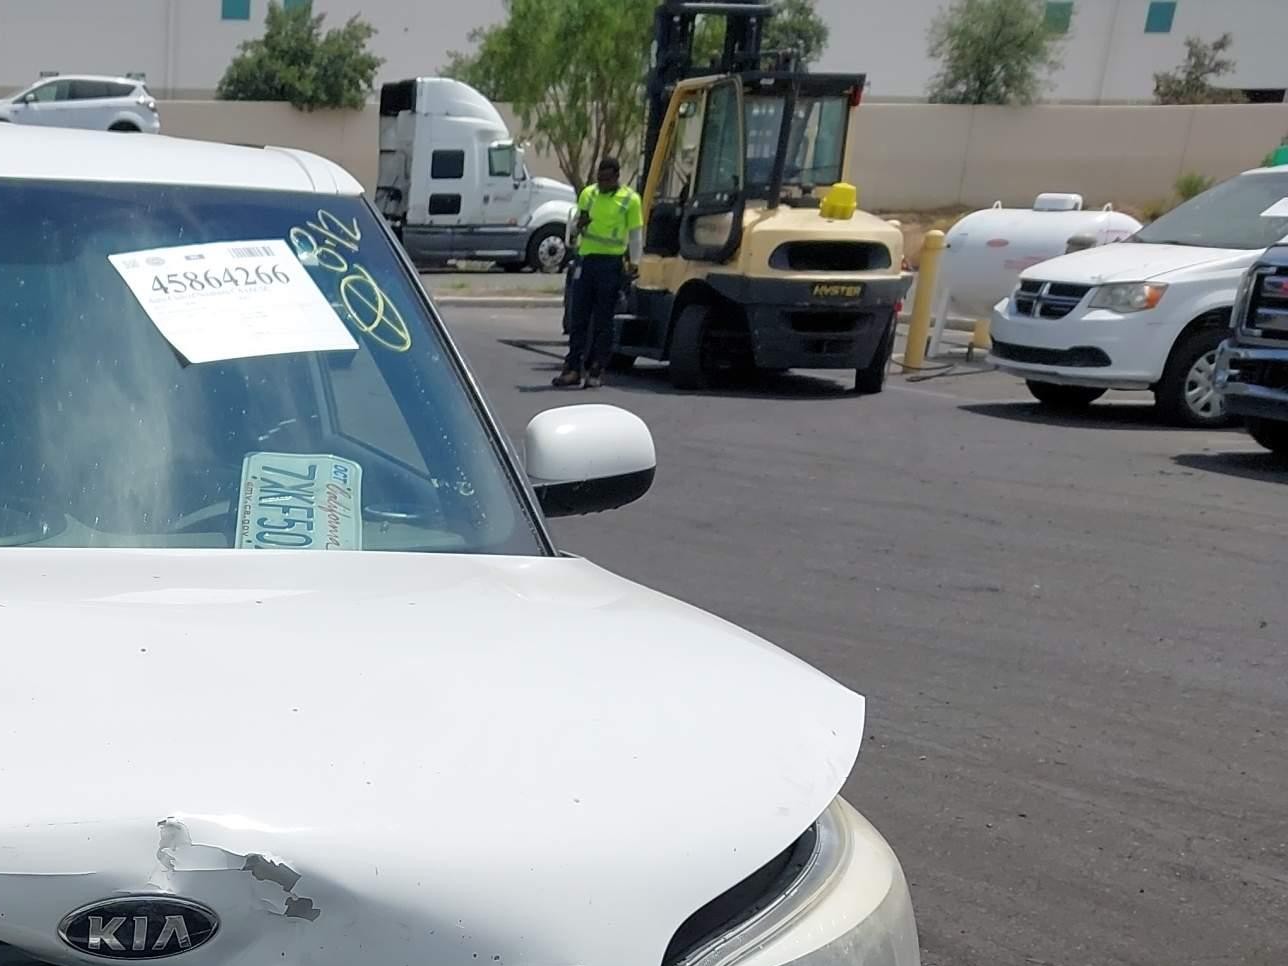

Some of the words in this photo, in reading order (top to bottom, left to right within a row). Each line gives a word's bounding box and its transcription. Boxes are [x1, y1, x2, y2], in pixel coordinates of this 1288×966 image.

[150, 263, 291, 296] 45864266
[332, 463, 349, 485] OCT
[254, 464, 317, 550] 7XKF50
[318, 482, 352, 550] California
[87, 915, 192, 950] KIA
